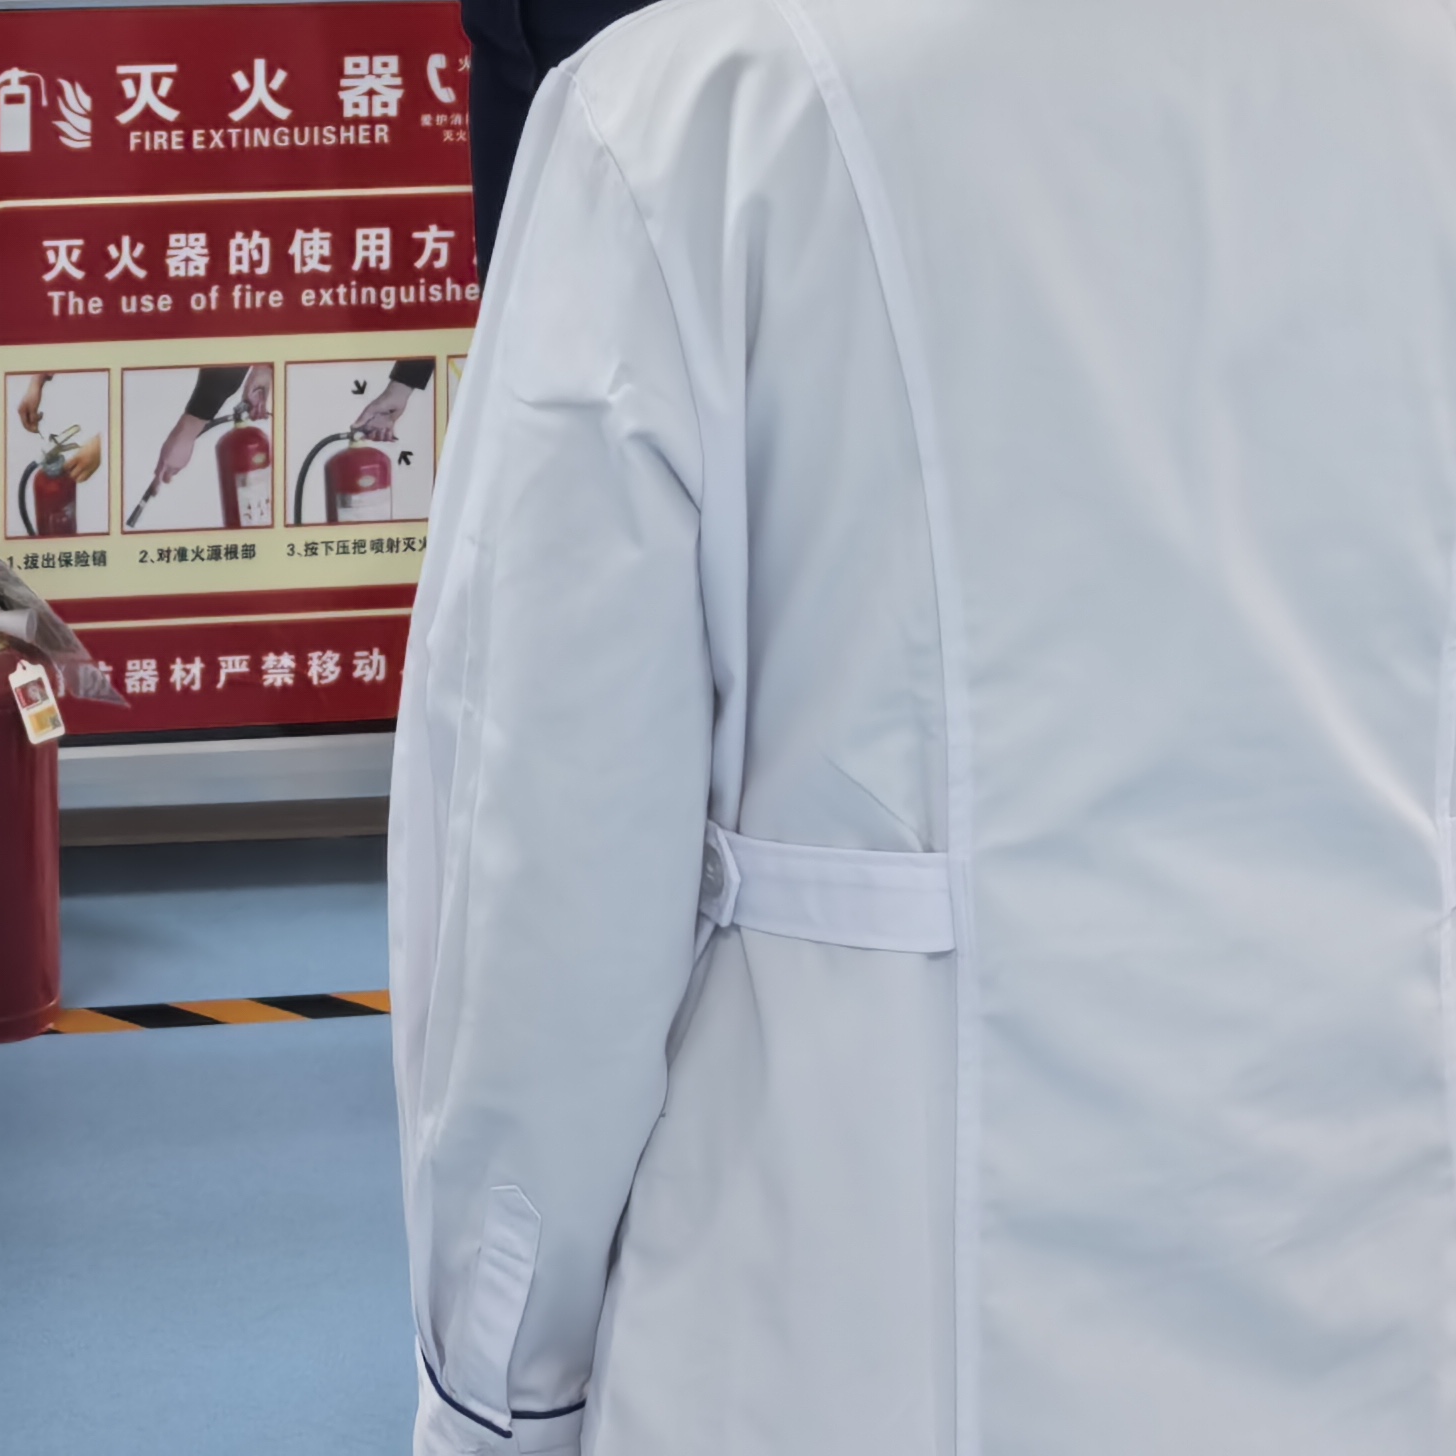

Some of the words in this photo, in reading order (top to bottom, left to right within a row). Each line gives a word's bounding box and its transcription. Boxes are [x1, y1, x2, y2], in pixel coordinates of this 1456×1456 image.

[115, 55, 404, 124] 灭火器
[129, 131, 185, 151] FIRE
[192, 124, 390, 150] EXTINGUISHER
[421, 113, 469, 127] 爱护消
[41, 224, 477, 282] 灭火器的使用方
[48, 291, 103, 316] The
[120, 290, 173, 313] use
[190, 285, 219, 310] of
[232, 284, 284, 309] fire
[55, 647, 403, 698] 防器材严禁移动
